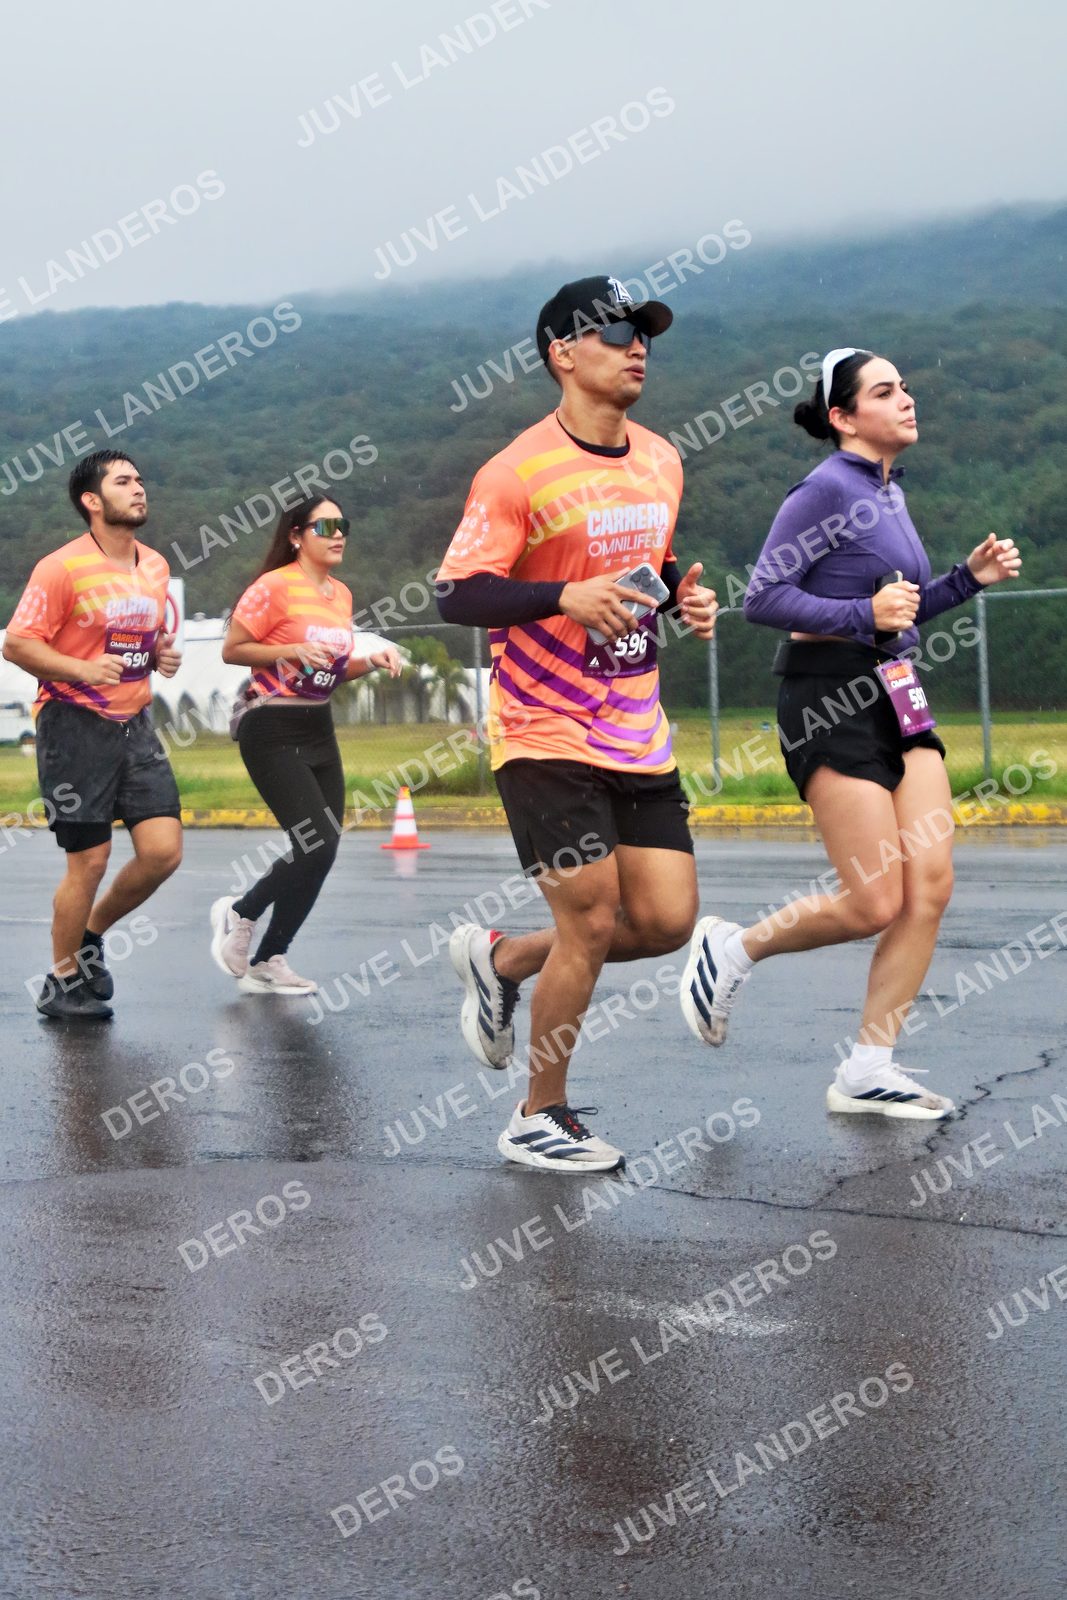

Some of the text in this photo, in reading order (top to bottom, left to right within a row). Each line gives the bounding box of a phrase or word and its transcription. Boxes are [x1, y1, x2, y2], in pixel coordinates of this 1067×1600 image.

[588, 502, 668, 537] CARRERA
[588, 532, 653, 557] OMNILIFE
[111, 632, 142, 642] CARRERA
[614, 630, 648, 657] 596
[122, 651, 149, 667] 690
[313, 670, 336, 688] 691
